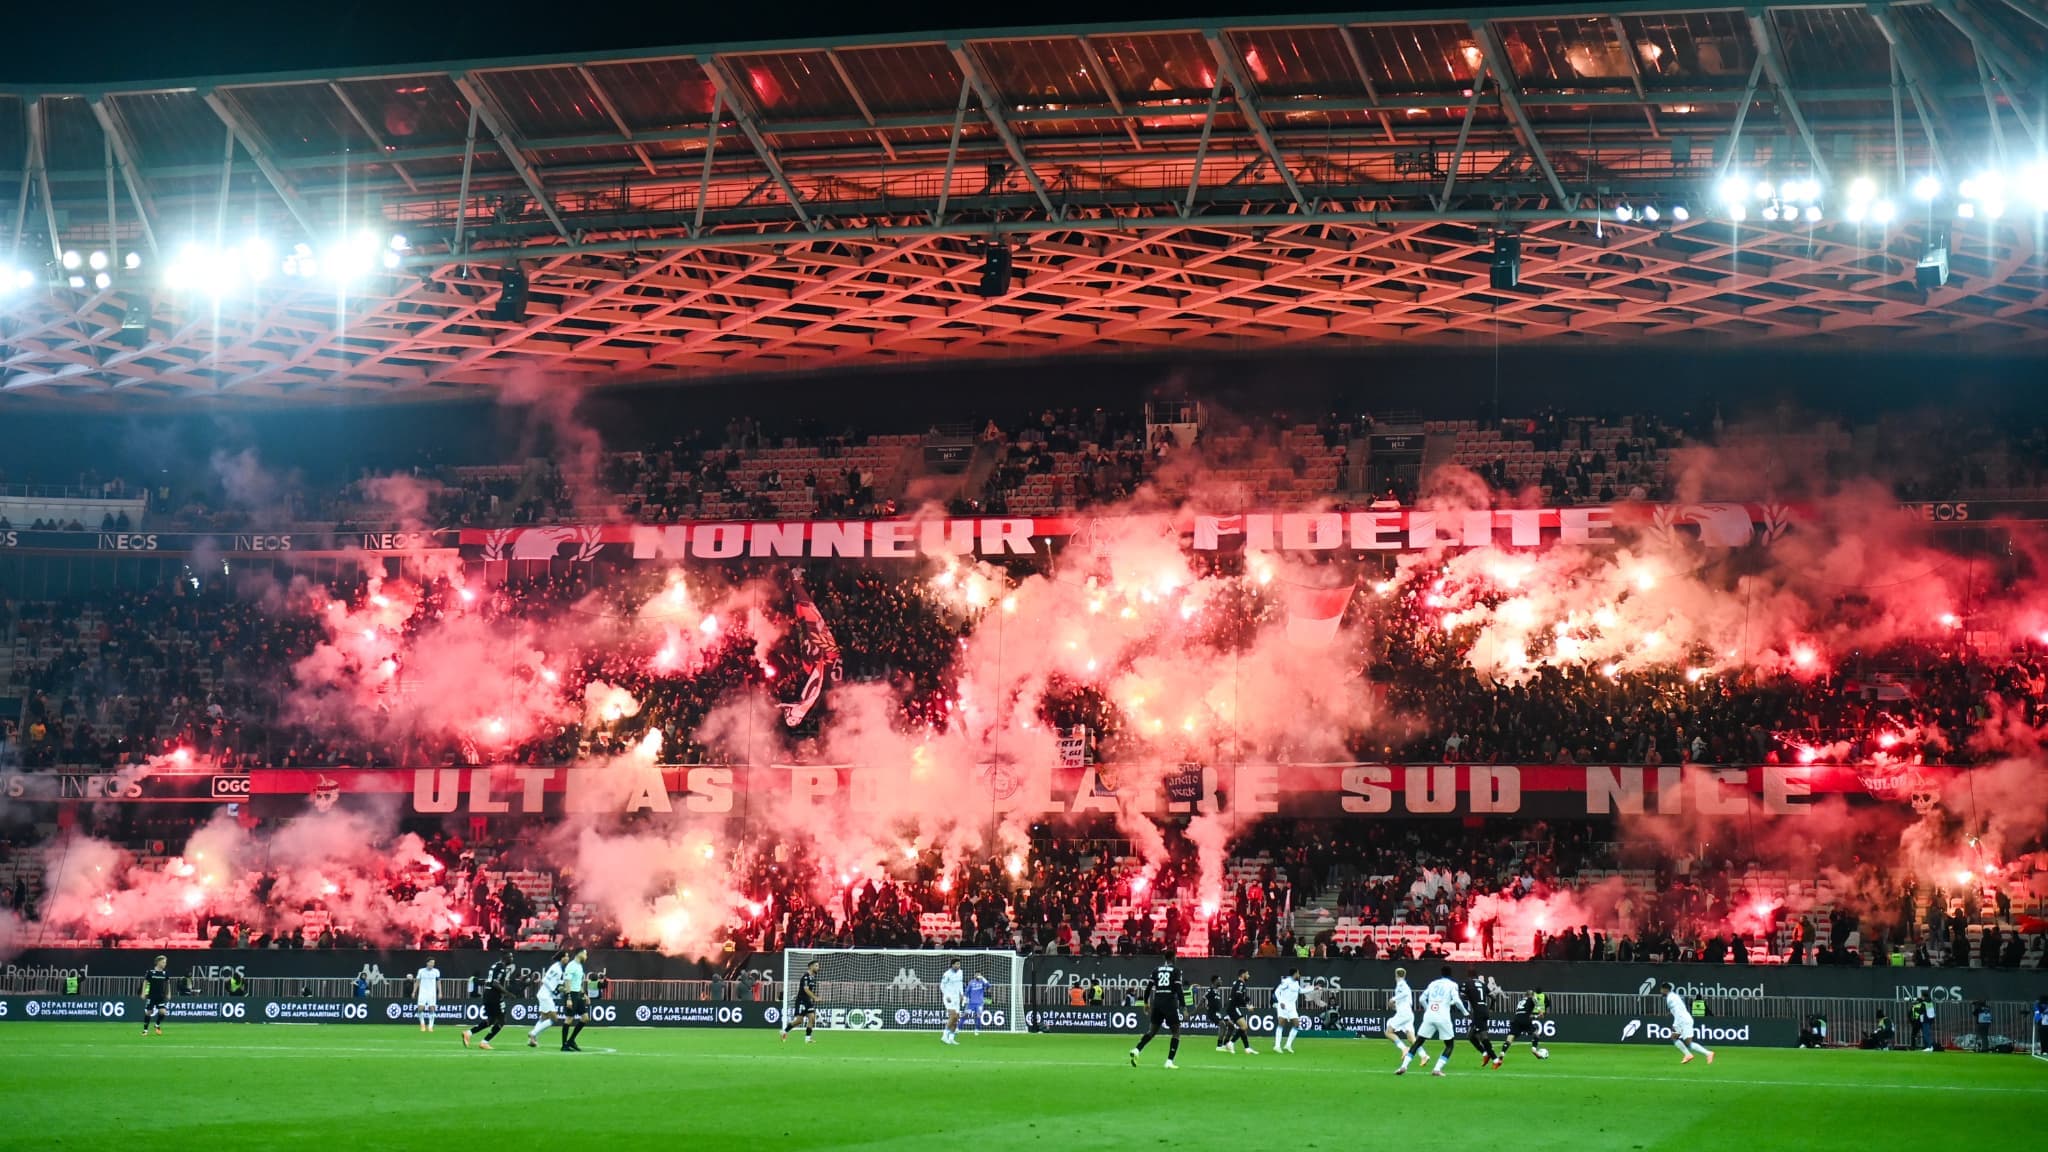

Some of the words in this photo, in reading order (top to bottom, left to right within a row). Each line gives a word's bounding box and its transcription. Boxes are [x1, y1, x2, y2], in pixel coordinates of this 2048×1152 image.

[97, 533, 158, 550] INEOS
[234, 535, 293, 551] INEOS
[60, 775, 144, 798] INEOS
[217, 780, 250, 793] OGC
[1341, 765, 1521, 814] SUD
[1585, 766, 1813, 815] NICE
[192, 965, 246, 981] INEOS
[1068, 972, 1150, 990] Robinhoo
[1157, 972, 1171, 987] 28
[1895, 985, 1963, 1003] INEOS
[41, 1000, 98, 1009] DÉPARTEMENT
[102, 1001, 125, 1017] 06
[165, 1001, 218, 1009] ÉPARTEMENT
[222, 1002, 246, 1018] 06
[281, 1002, 340, 1010] DÉPARTEMENT
[344, 1003, 368, 1019] 06
[652, 1005, 713, 1014] DÉPARTEMENT
[592, 1005, 616, 1021] 06
[718, 1006, 743, 1022] 06
[980, 1010, 1005, 1026] 06
[1043, 1010, 1107, 1020] DÉPARTEMENT
[1111, 1012, 1138, 1029] 06
[1056, 1019, 1107, 1027] ALPES-MARITIMES
[1248, 1015, 1274, 1031] 06
[1646, 1023, 1749, 1041] Ronhood
